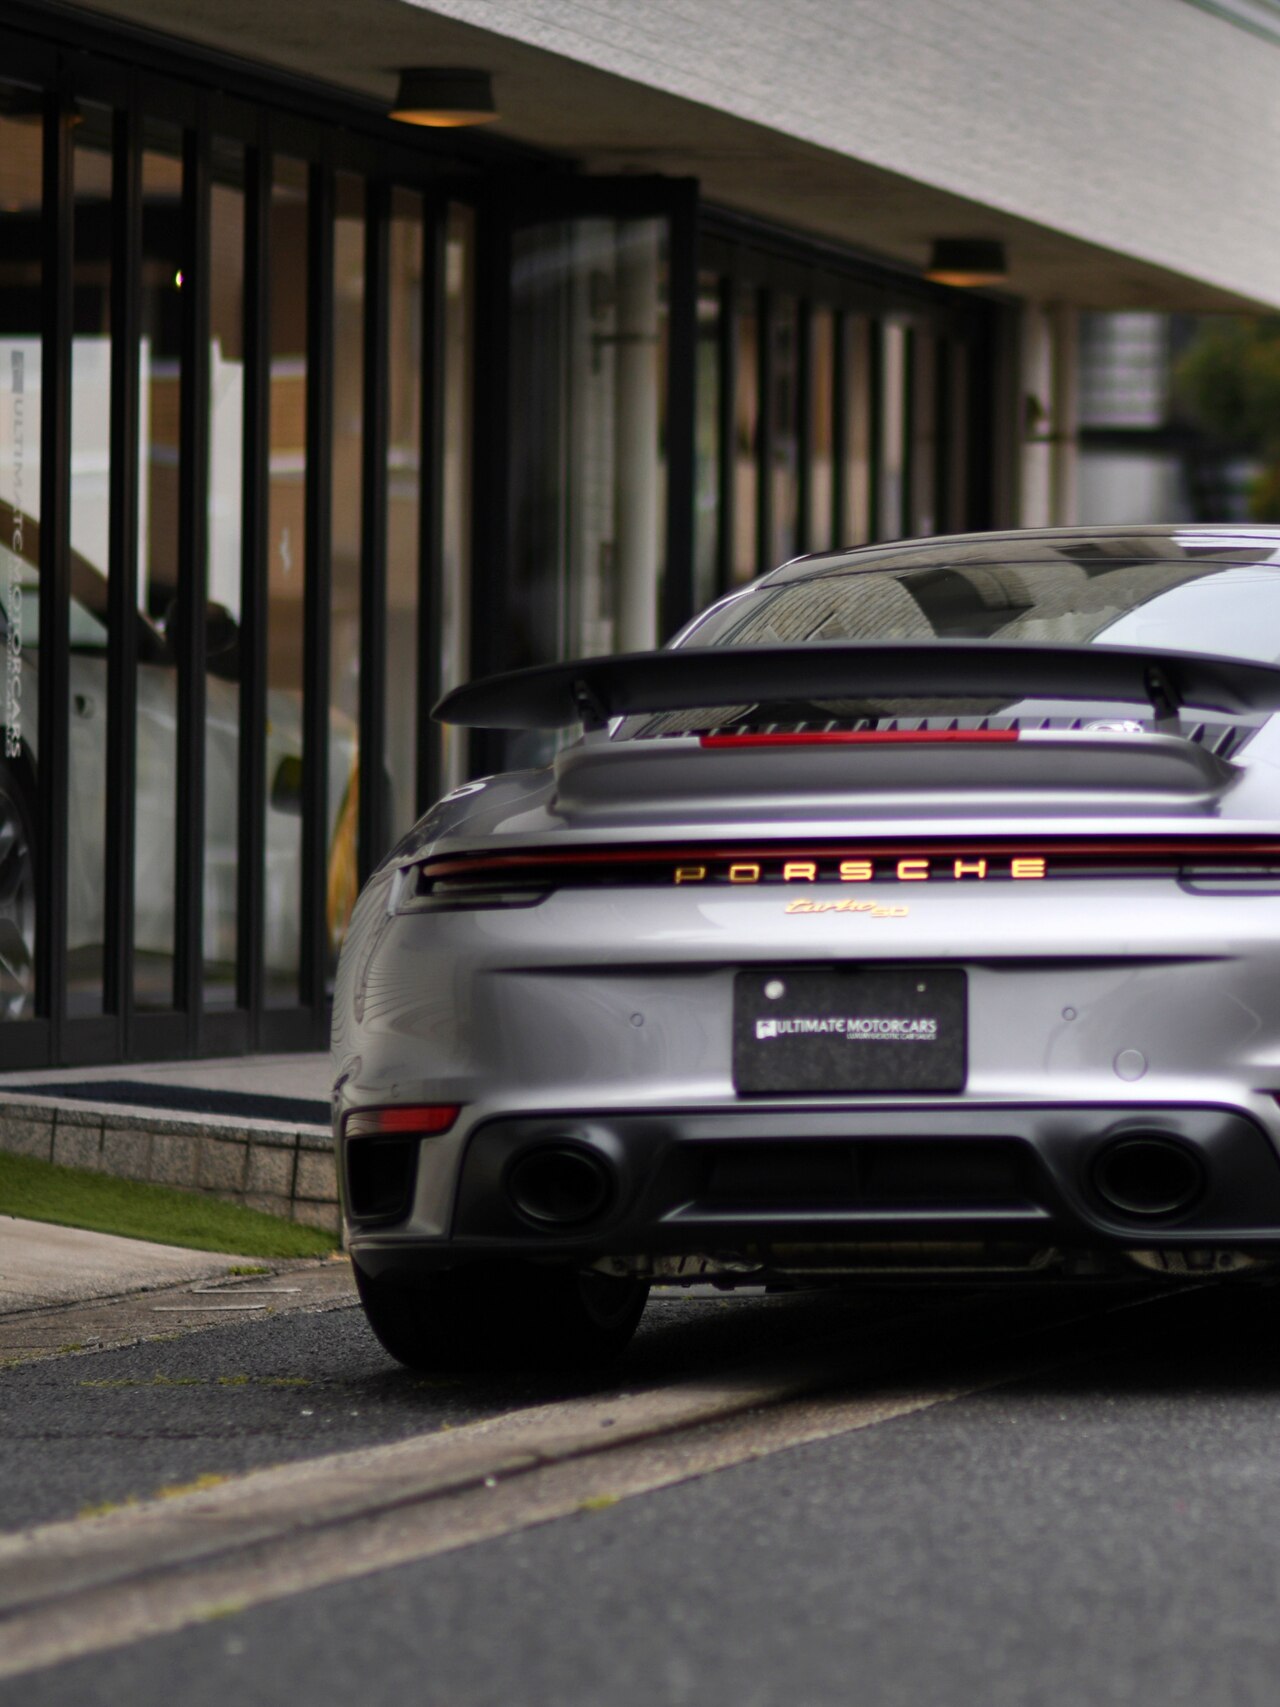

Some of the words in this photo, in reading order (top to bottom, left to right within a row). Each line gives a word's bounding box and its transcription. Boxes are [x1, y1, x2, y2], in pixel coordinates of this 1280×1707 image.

[675, 858, 1046, 884] PORSCHE
[777, 1018, 846, 1033] ULTIMATE
[847, 1018, 937, 1033] MOTORCARS
